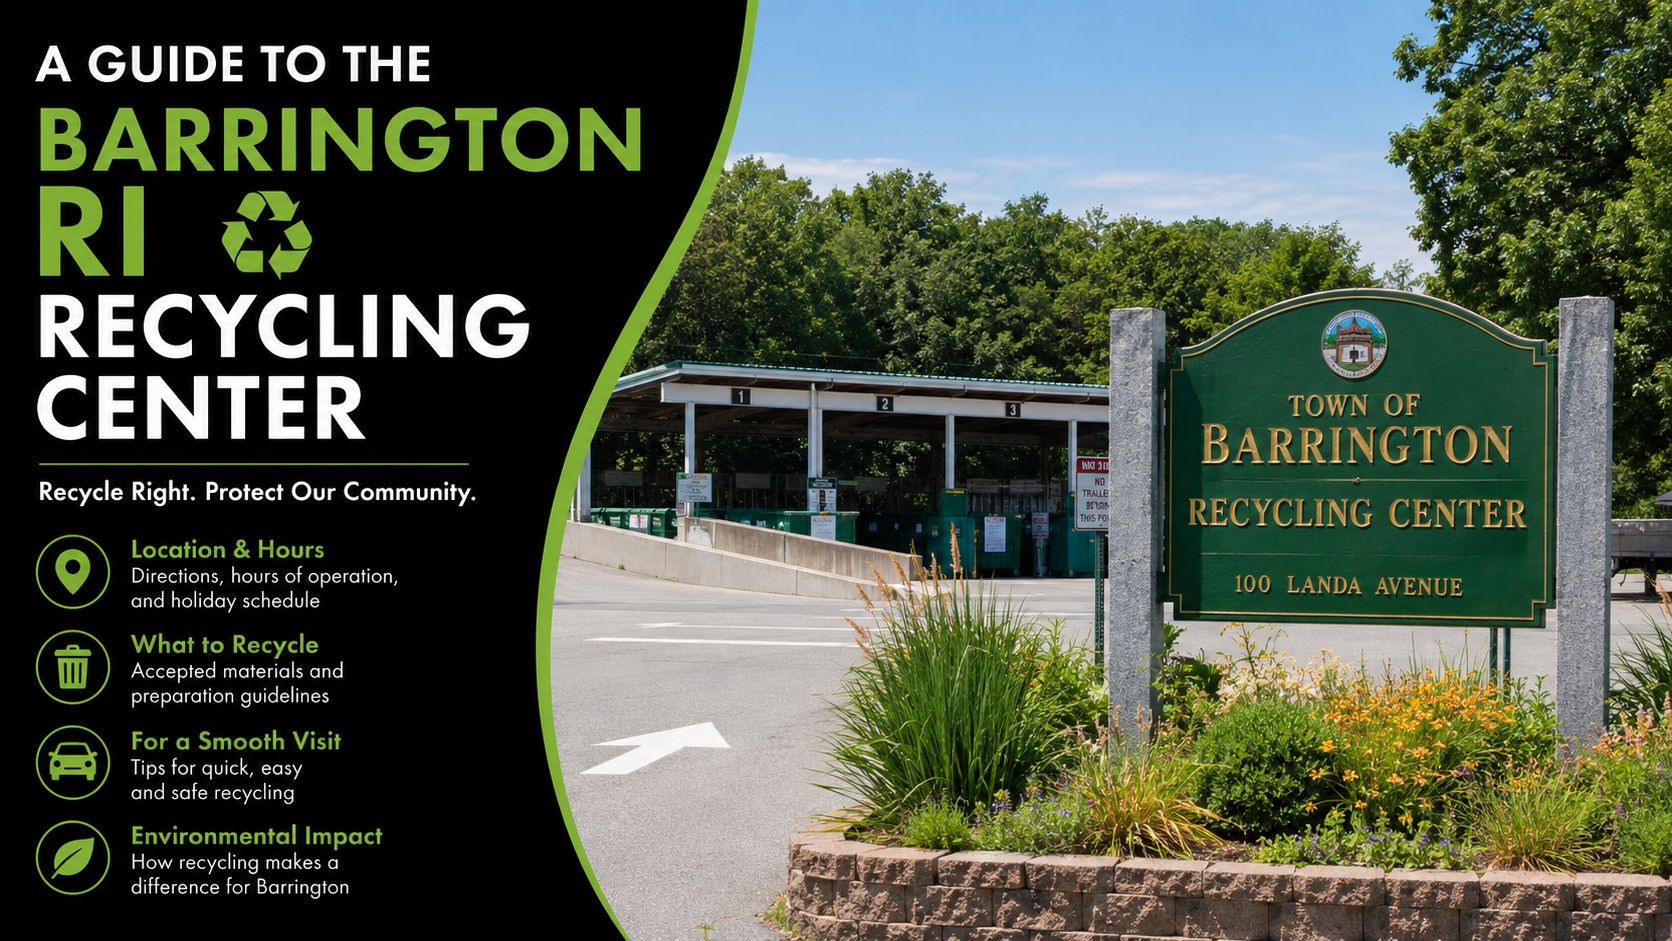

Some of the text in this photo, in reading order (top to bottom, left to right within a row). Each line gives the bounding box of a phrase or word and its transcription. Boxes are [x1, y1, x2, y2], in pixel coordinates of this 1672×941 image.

[738, 390, 744, 403] 1
[881, 397, 889, 410] 2
[1010, 404, 1016, 416] 3
[1288, 393, 1420, 417] TOWN OF
[1202, 424, 1512, 464] BARRINGTON
[1094, 477, 1106, 486] NO
[1190, 498, 1526, 528] RECYCLING CENTER
[1237, 576, 1462, 595] 100 LANDA AVENUE
